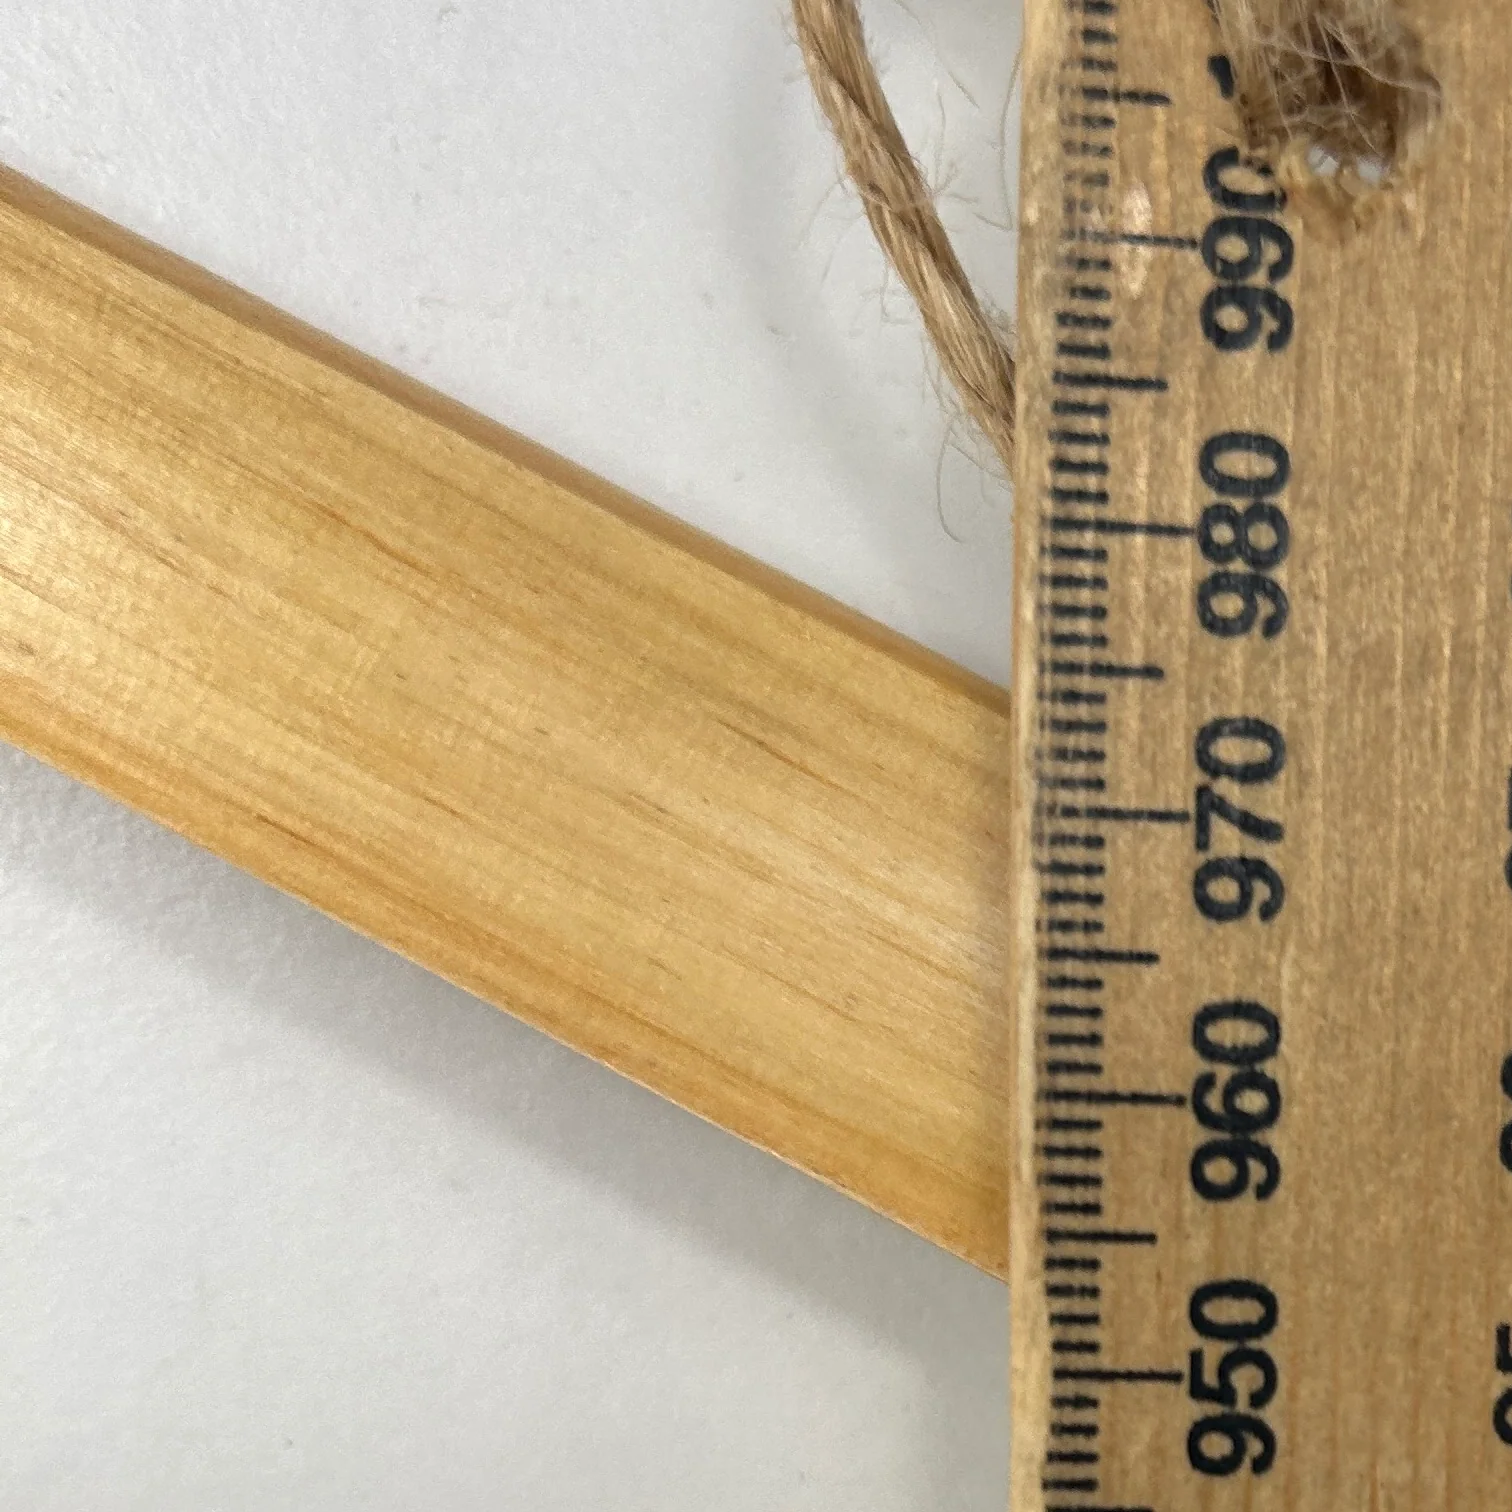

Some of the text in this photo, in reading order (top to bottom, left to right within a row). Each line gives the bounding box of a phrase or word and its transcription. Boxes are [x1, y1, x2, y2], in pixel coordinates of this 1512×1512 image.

[1199, 146, 1293, 352] 990
[1196, 432, 1290, 639] 980
[1193, 717, 1285, 923] 970
[1189, 999, 1281, 1203] 960
[1186, 1279, 1279, 1477] 950
